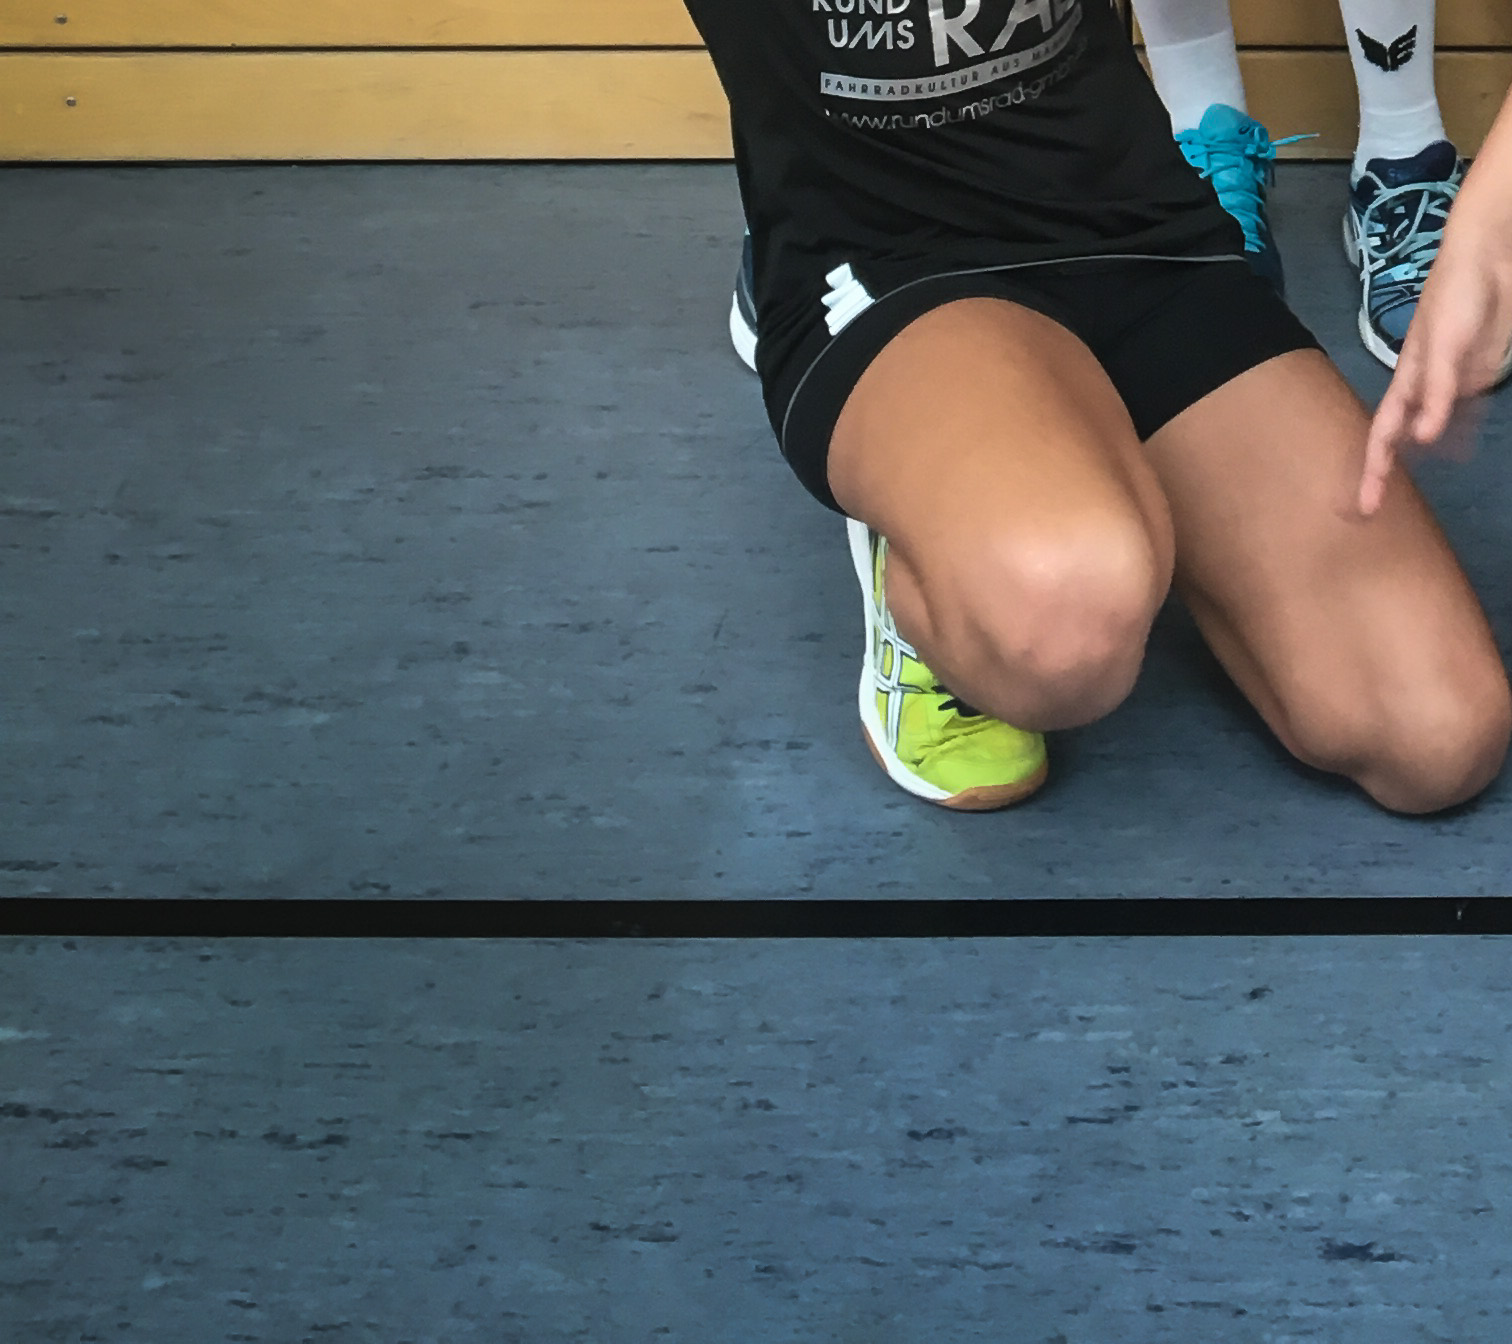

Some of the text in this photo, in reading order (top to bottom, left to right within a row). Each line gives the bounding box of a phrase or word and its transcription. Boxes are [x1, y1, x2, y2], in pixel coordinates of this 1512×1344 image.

[827, 19, 915, 50] UMS
[824, 58, 1020, 96] FAHRRADKULTUR AUS
